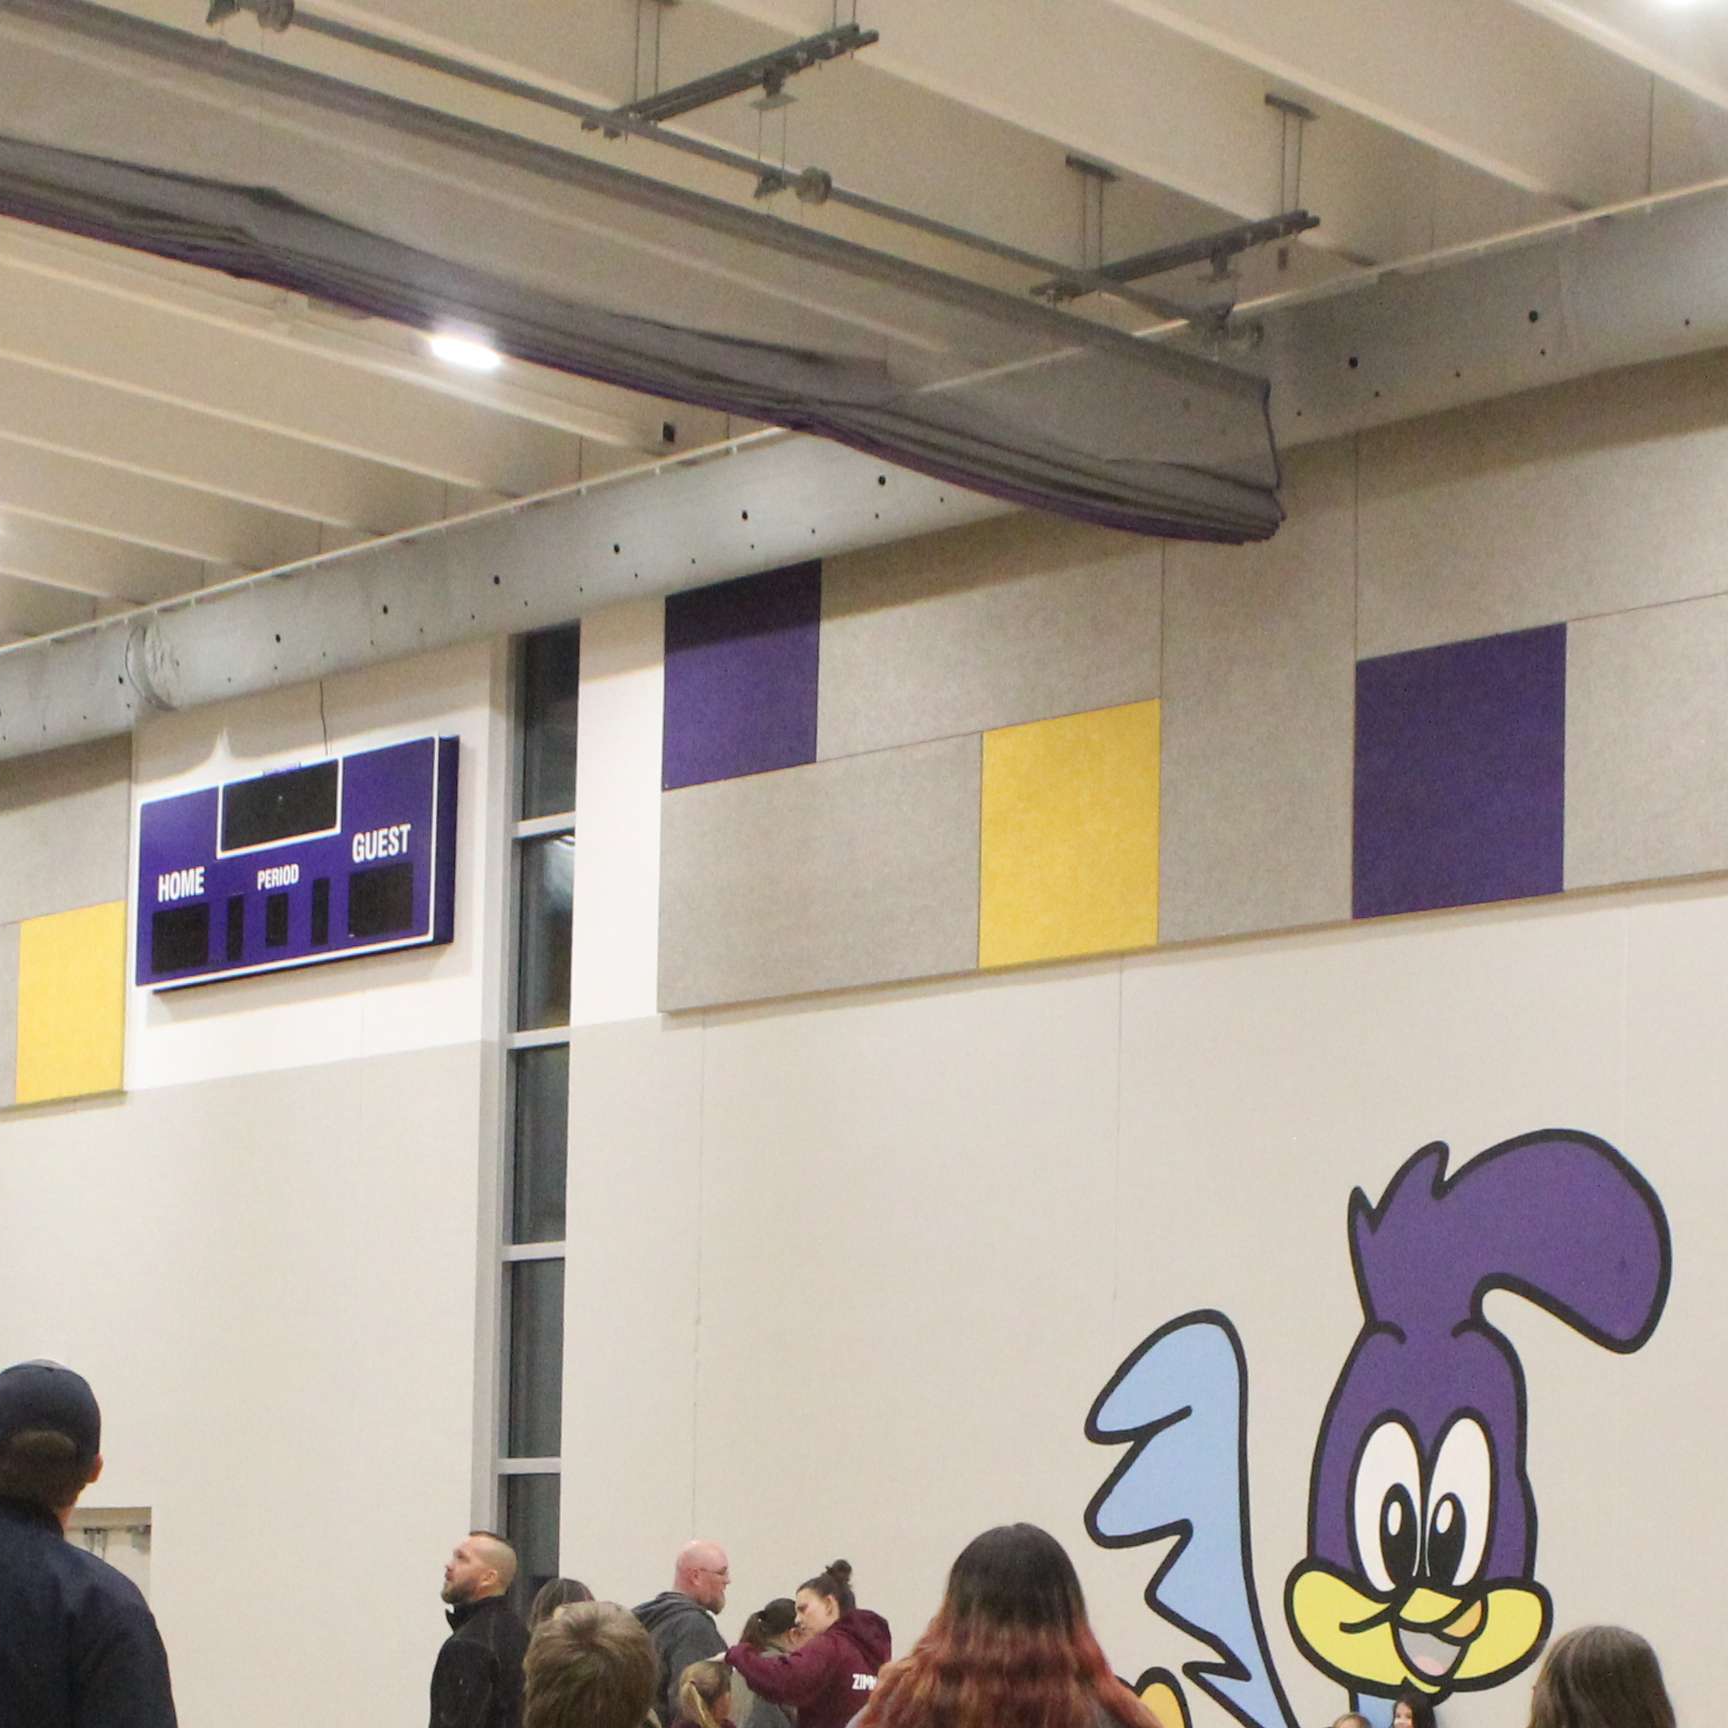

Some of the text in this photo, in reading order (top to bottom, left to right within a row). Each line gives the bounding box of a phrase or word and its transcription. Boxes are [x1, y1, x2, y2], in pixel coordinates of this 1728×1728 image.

[352, 822, 412, 864] GUEST
[157, 866, 205, 903] HOME
[257, 863, 300, 891] PERIOD
